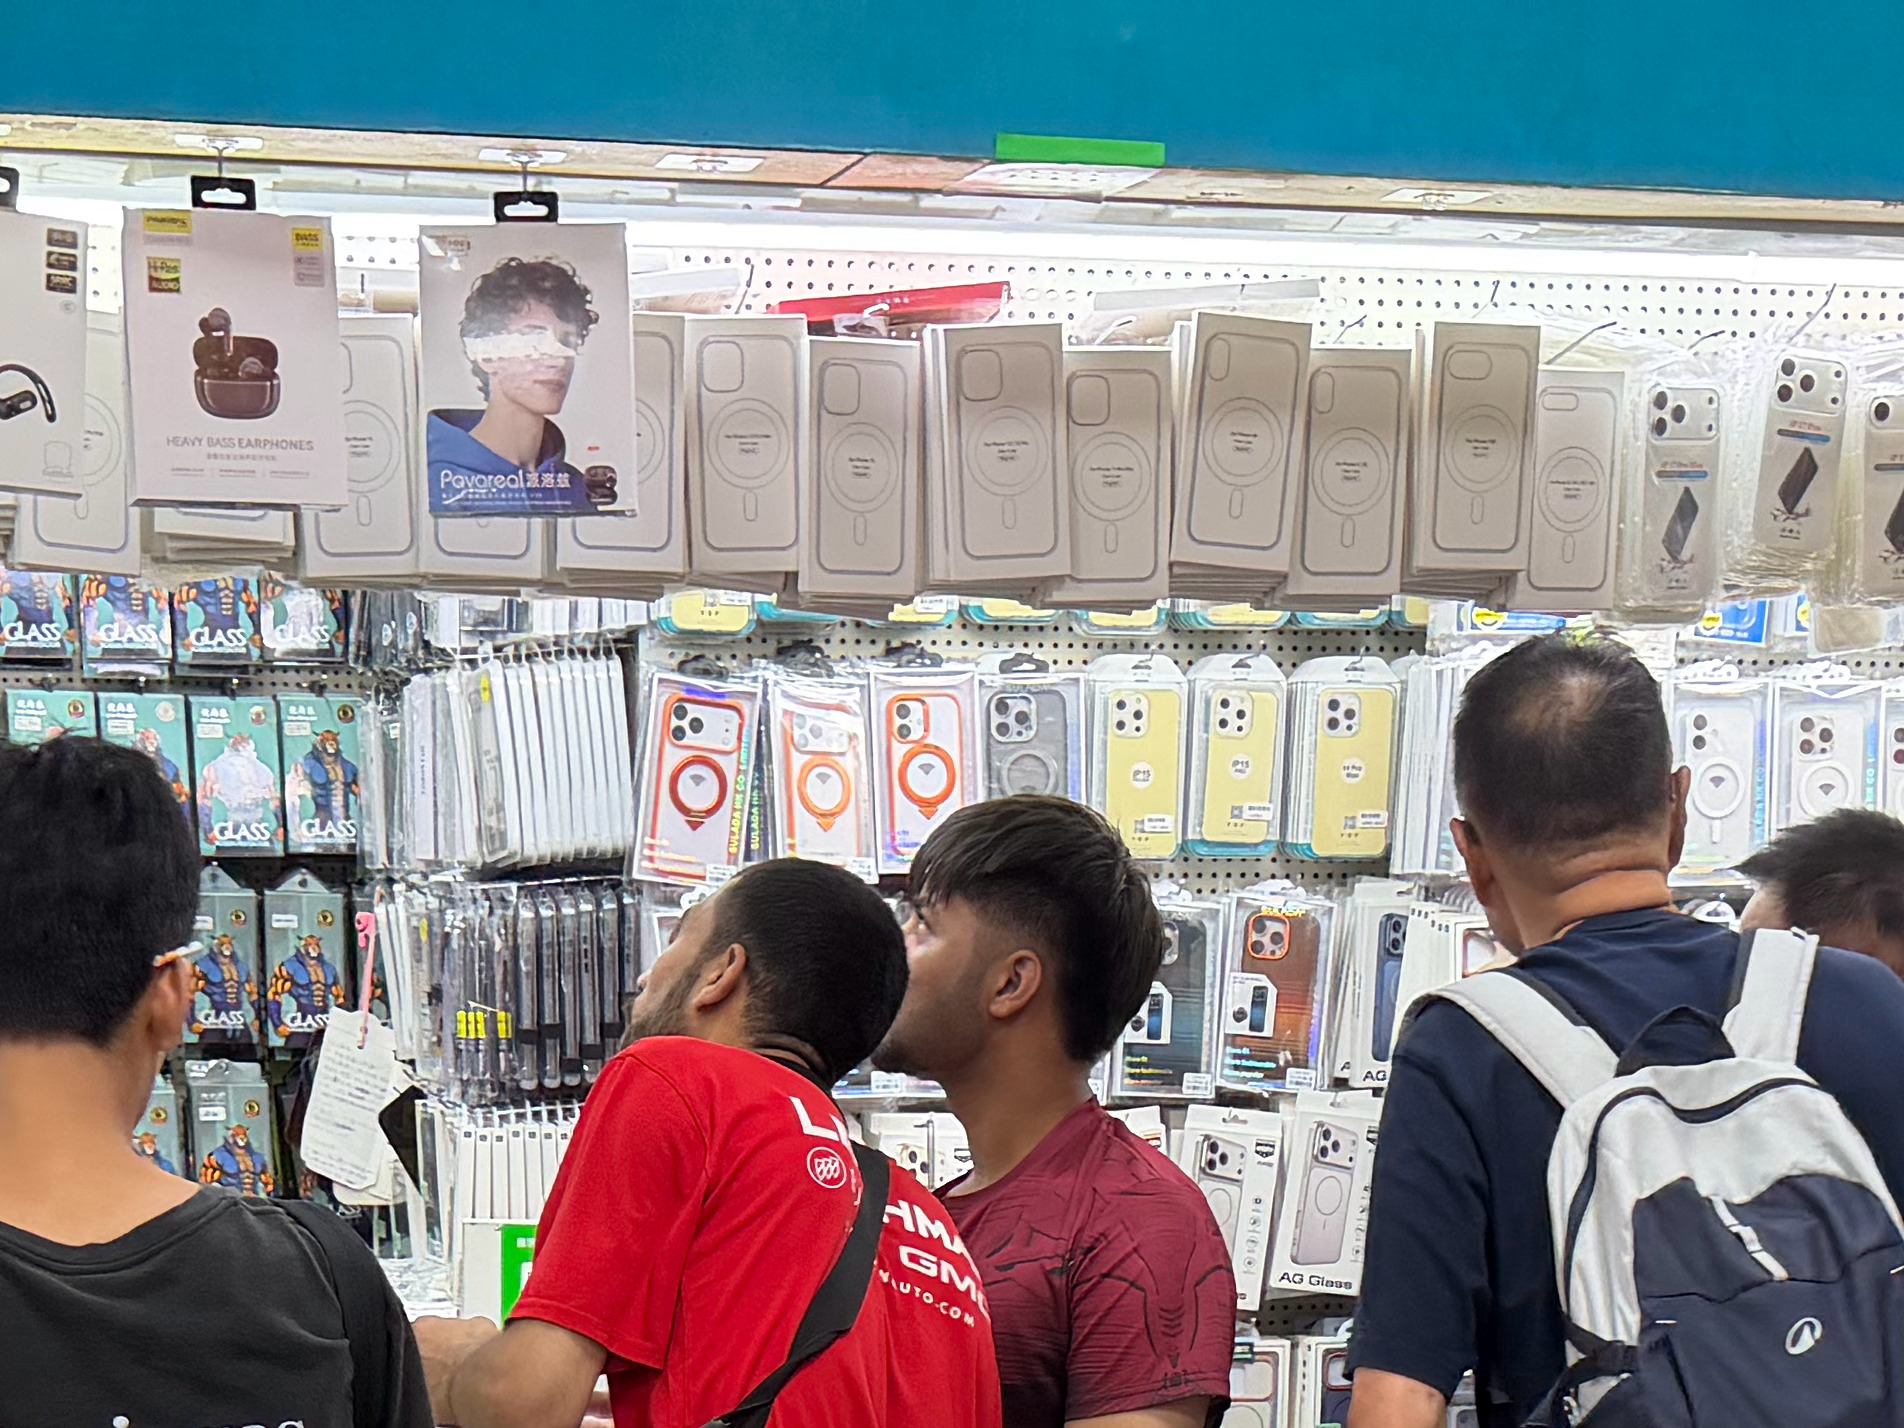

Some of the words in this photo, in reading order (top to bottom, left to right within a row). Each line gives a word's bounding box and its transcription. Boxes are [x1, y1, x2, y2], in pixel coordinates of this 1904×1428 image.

[166, 436, 203, 447] HEAVY
[207, 437, 236, 449] BASS
[238, 438, 314, 451] EARPHONES
[440, 469, 525, 489] Pavareal
[4, 621, 61, 641] GLASS
[99, 622, 158, 642] GLASS
[190, 626, 246, 647] GLASS
[215, 820, 271, 841] GLASS
[301, 818, 357, 837] GLASS
[201, 1009, 245, 1026] GLASS
[1279, 1271, 1304, 1285] AG
[1308, 1274, 1353, 1290] Glass
